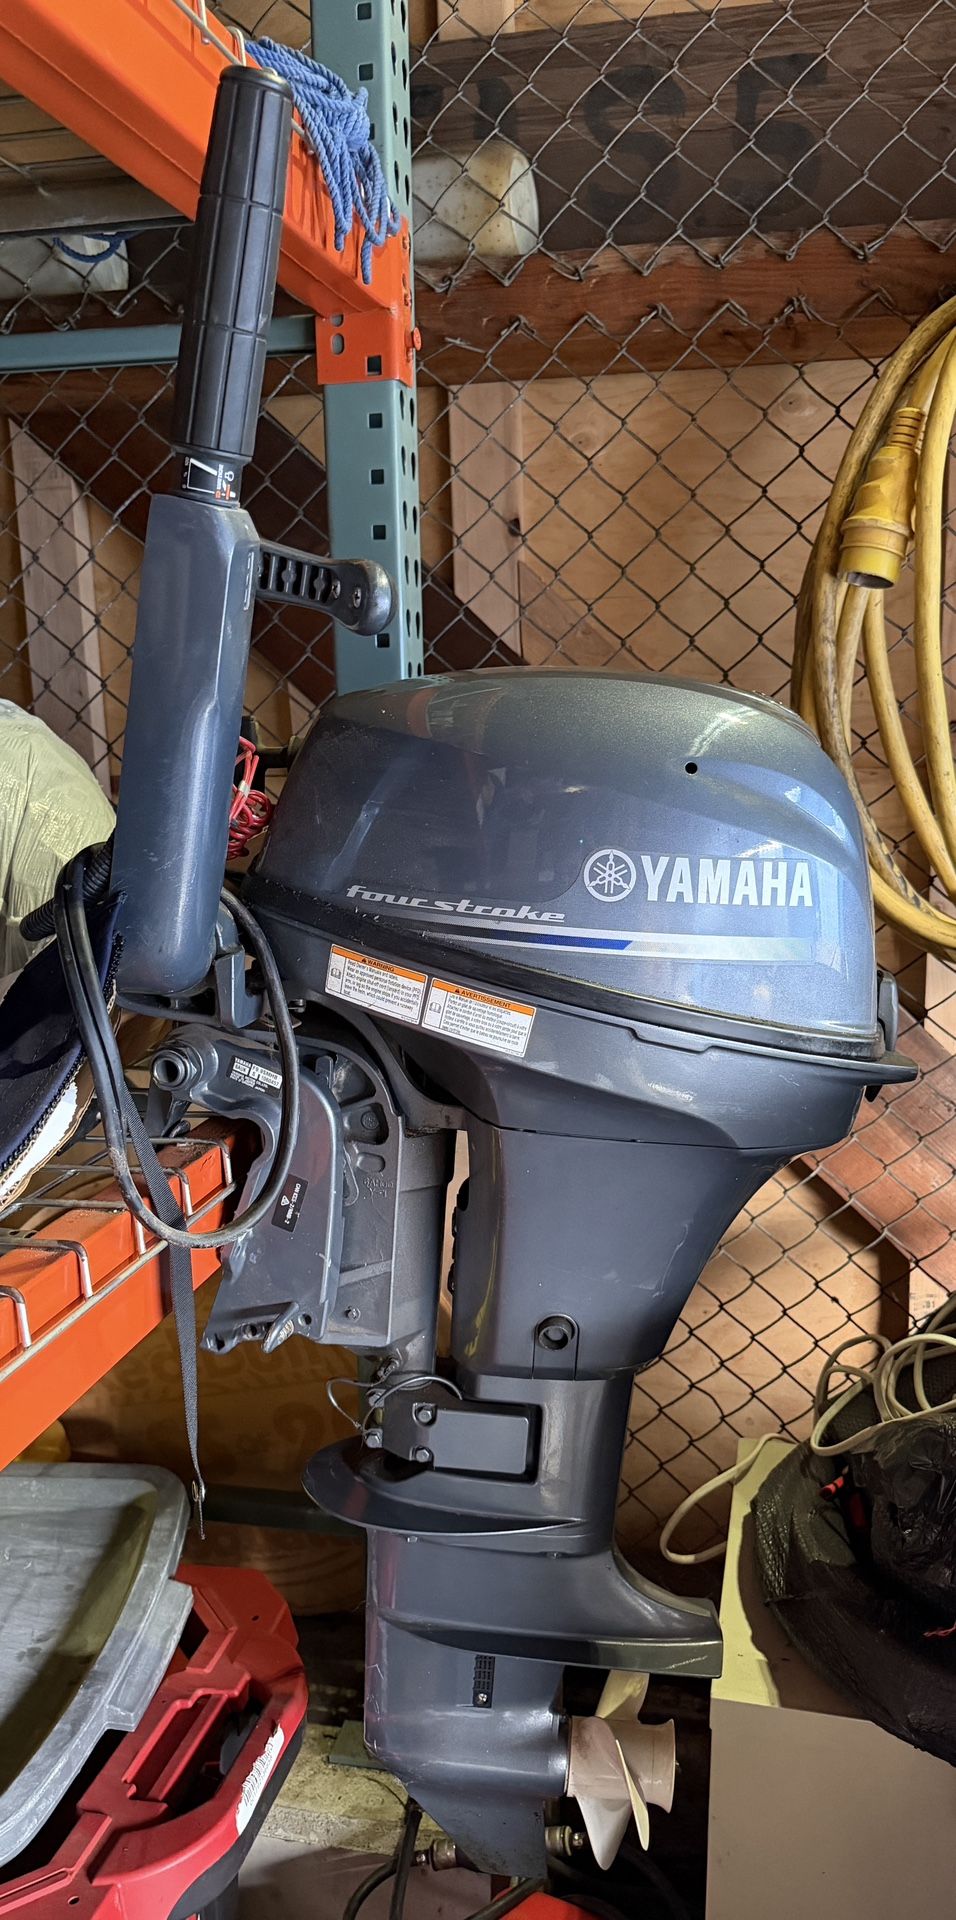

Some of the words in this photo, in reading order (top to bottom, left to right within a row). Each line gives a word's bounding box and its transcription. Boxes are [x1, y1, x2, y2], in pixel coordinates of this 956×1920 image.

[641, 855, 814, 907] YAMAHA
[367, 959, 395, 972] WARNING
[461, 990, 512, 1009] AVERTISSEMENT
